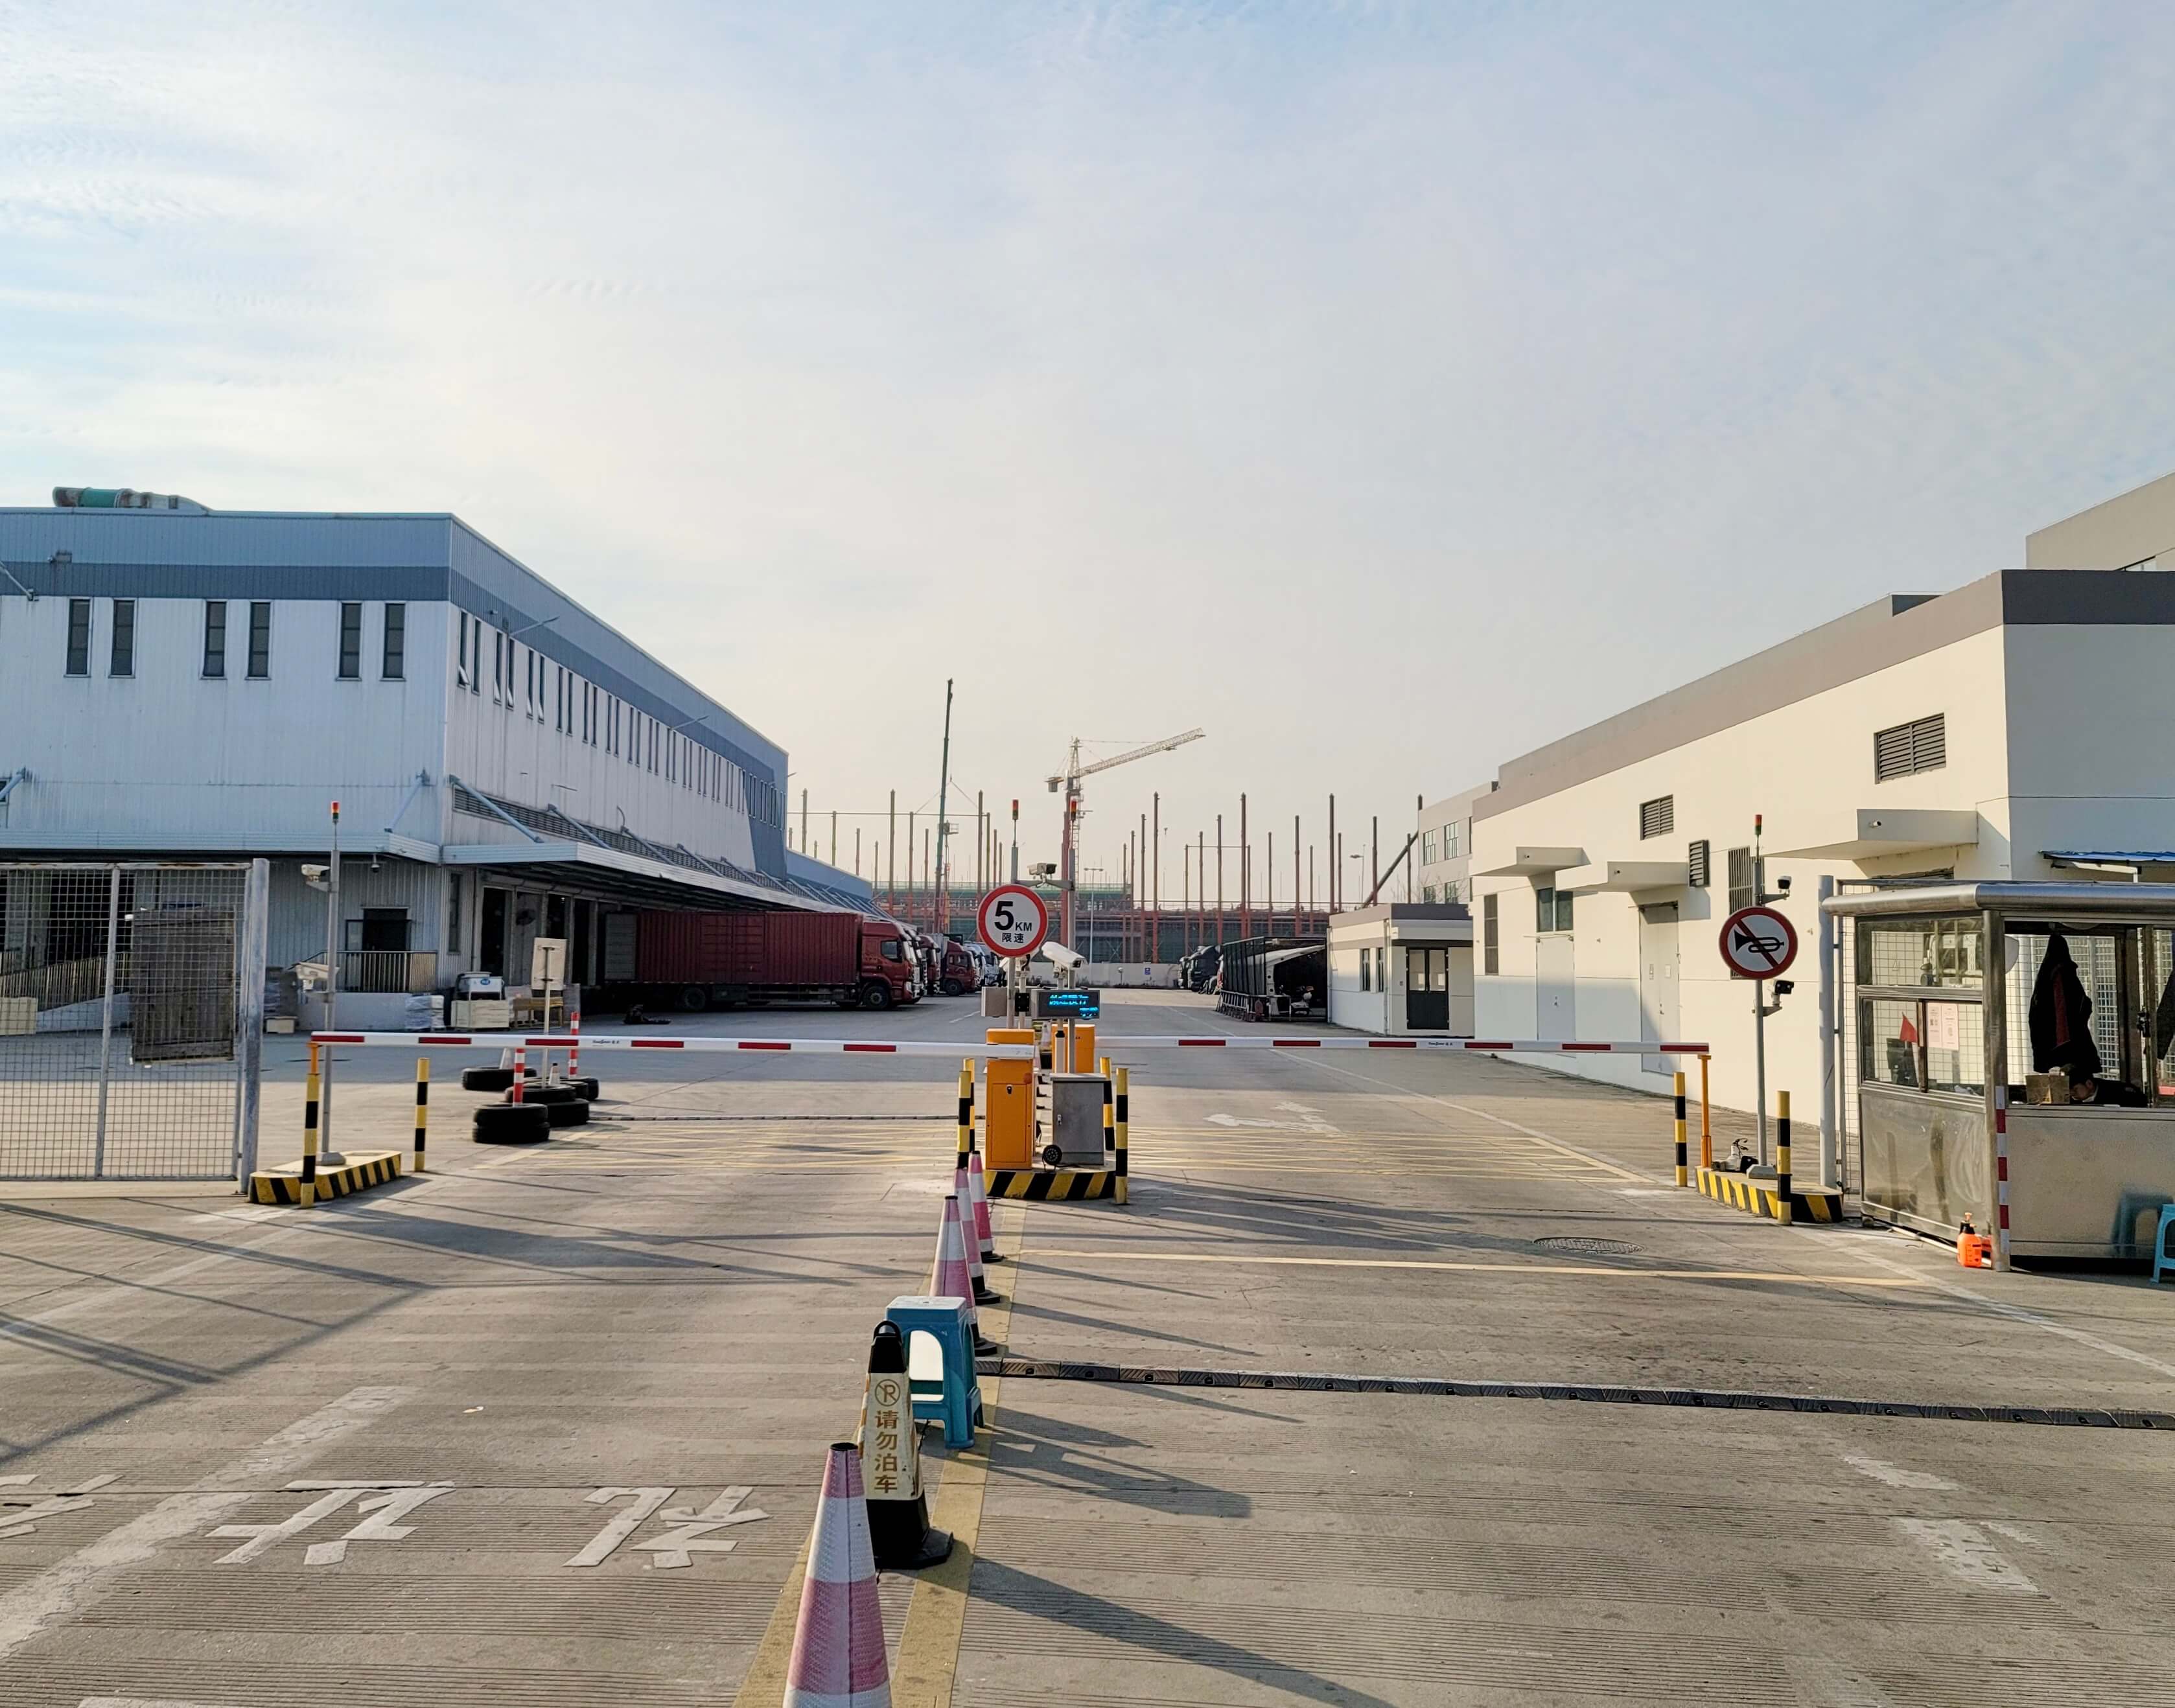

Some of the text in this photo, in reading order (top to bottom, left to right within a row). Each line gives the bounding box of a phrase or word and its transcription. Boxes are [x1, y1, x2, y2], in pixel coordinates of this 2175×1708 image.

[1001, 933, 1024, 943] 限速
[875, 1410, 899, 1494] 请勿泊车
